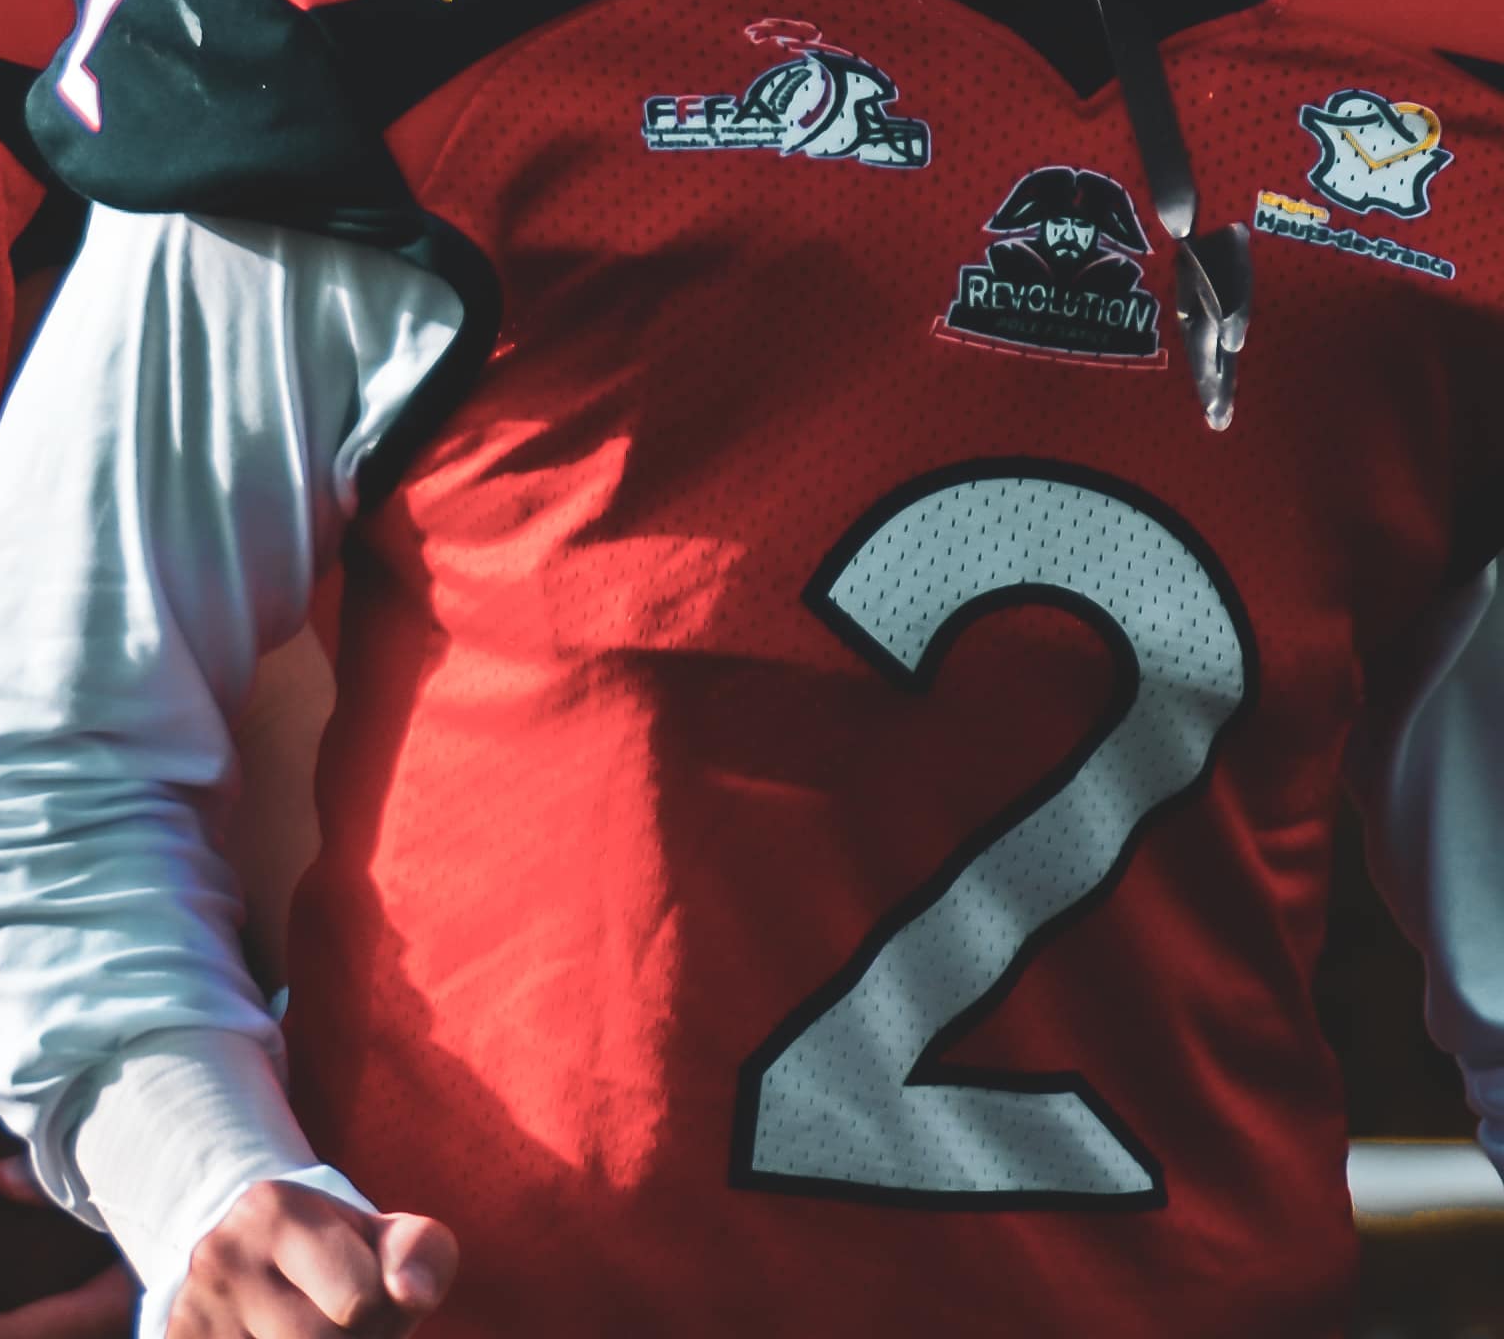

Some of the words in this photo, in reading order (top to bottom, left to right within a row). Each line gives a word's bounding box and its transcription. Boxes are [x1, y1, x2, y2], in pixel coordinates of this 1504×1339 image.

[646, 96, 782, 125] FFFA
[968, 275, 1152, 333] REVOLUTION
[728, 455, 1260, 1209] 2
